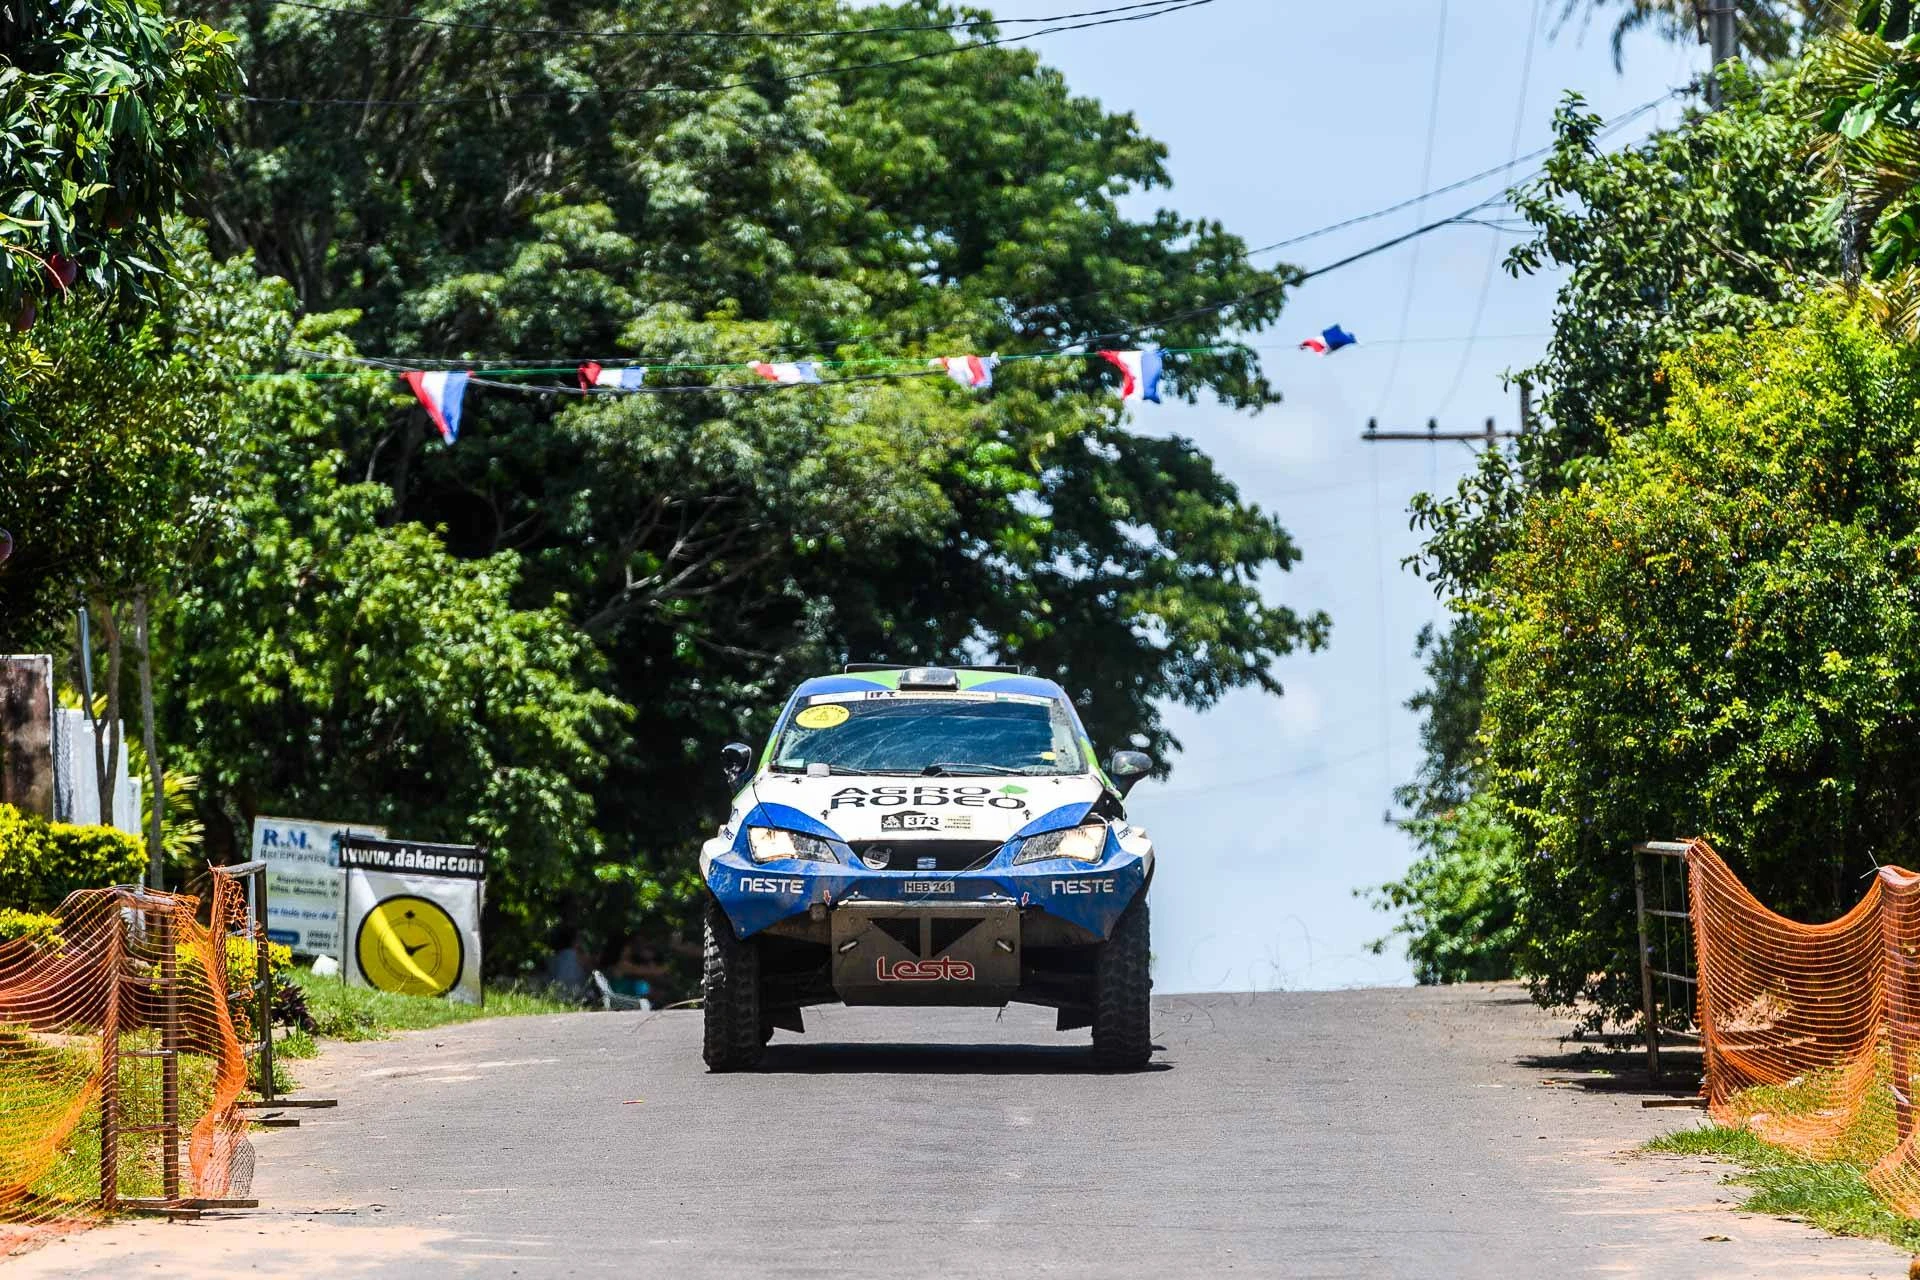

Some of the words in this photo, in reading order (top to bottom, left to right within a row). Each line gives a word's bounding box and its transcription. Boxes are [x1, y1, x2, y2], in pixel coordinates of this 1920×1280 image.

[831, 786, 991, 797] AGRO
[830, 795, 1026, 809] RODEO
[908, 816, 939, 826] 373
[342, 847, 484, 873] www.dakar.com
[740, 877, 805, 894] NESTE
[906, 882, 930, 892] HEB
[933, 882, 953, 892] 241
[1051, 879, 1115, 895] NESTE
[876, 956, 976, 981] Lesta
